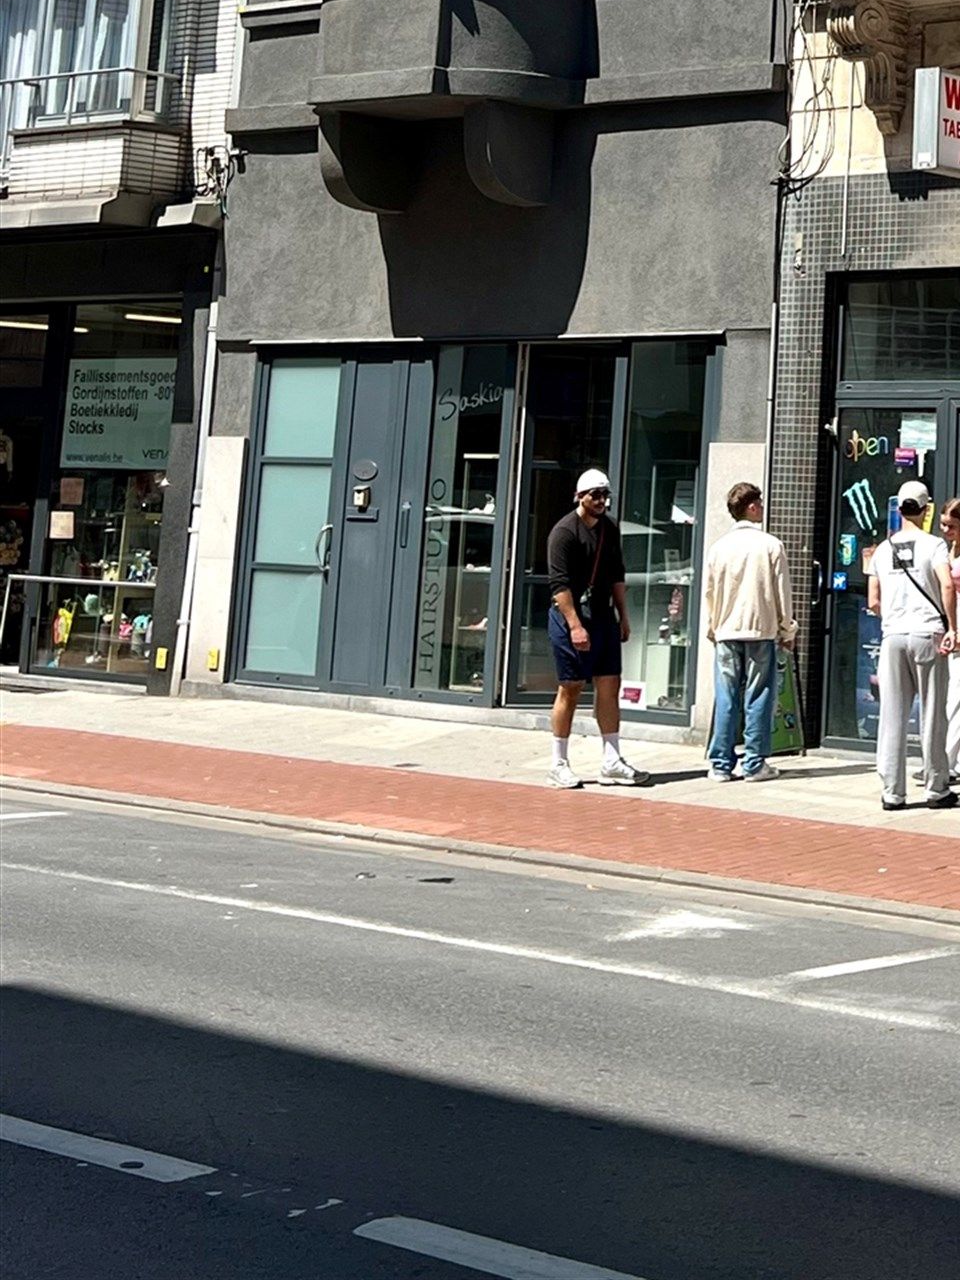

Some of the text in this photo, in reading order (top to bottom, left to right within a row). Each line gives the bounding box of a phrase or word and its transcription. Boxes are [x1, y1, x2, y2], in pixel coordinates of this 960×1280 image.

[72, 385, 176, 403] Gordijnstoffen -80
[439, 383, 503, 421] Saskia
[70, 403, 140, 421] Boetiekkledij
[68, 420, 105, 434] Stocks
[845, 429, 889, 462] open
[419, 478, 446, 673] HAIRSTUDIO
